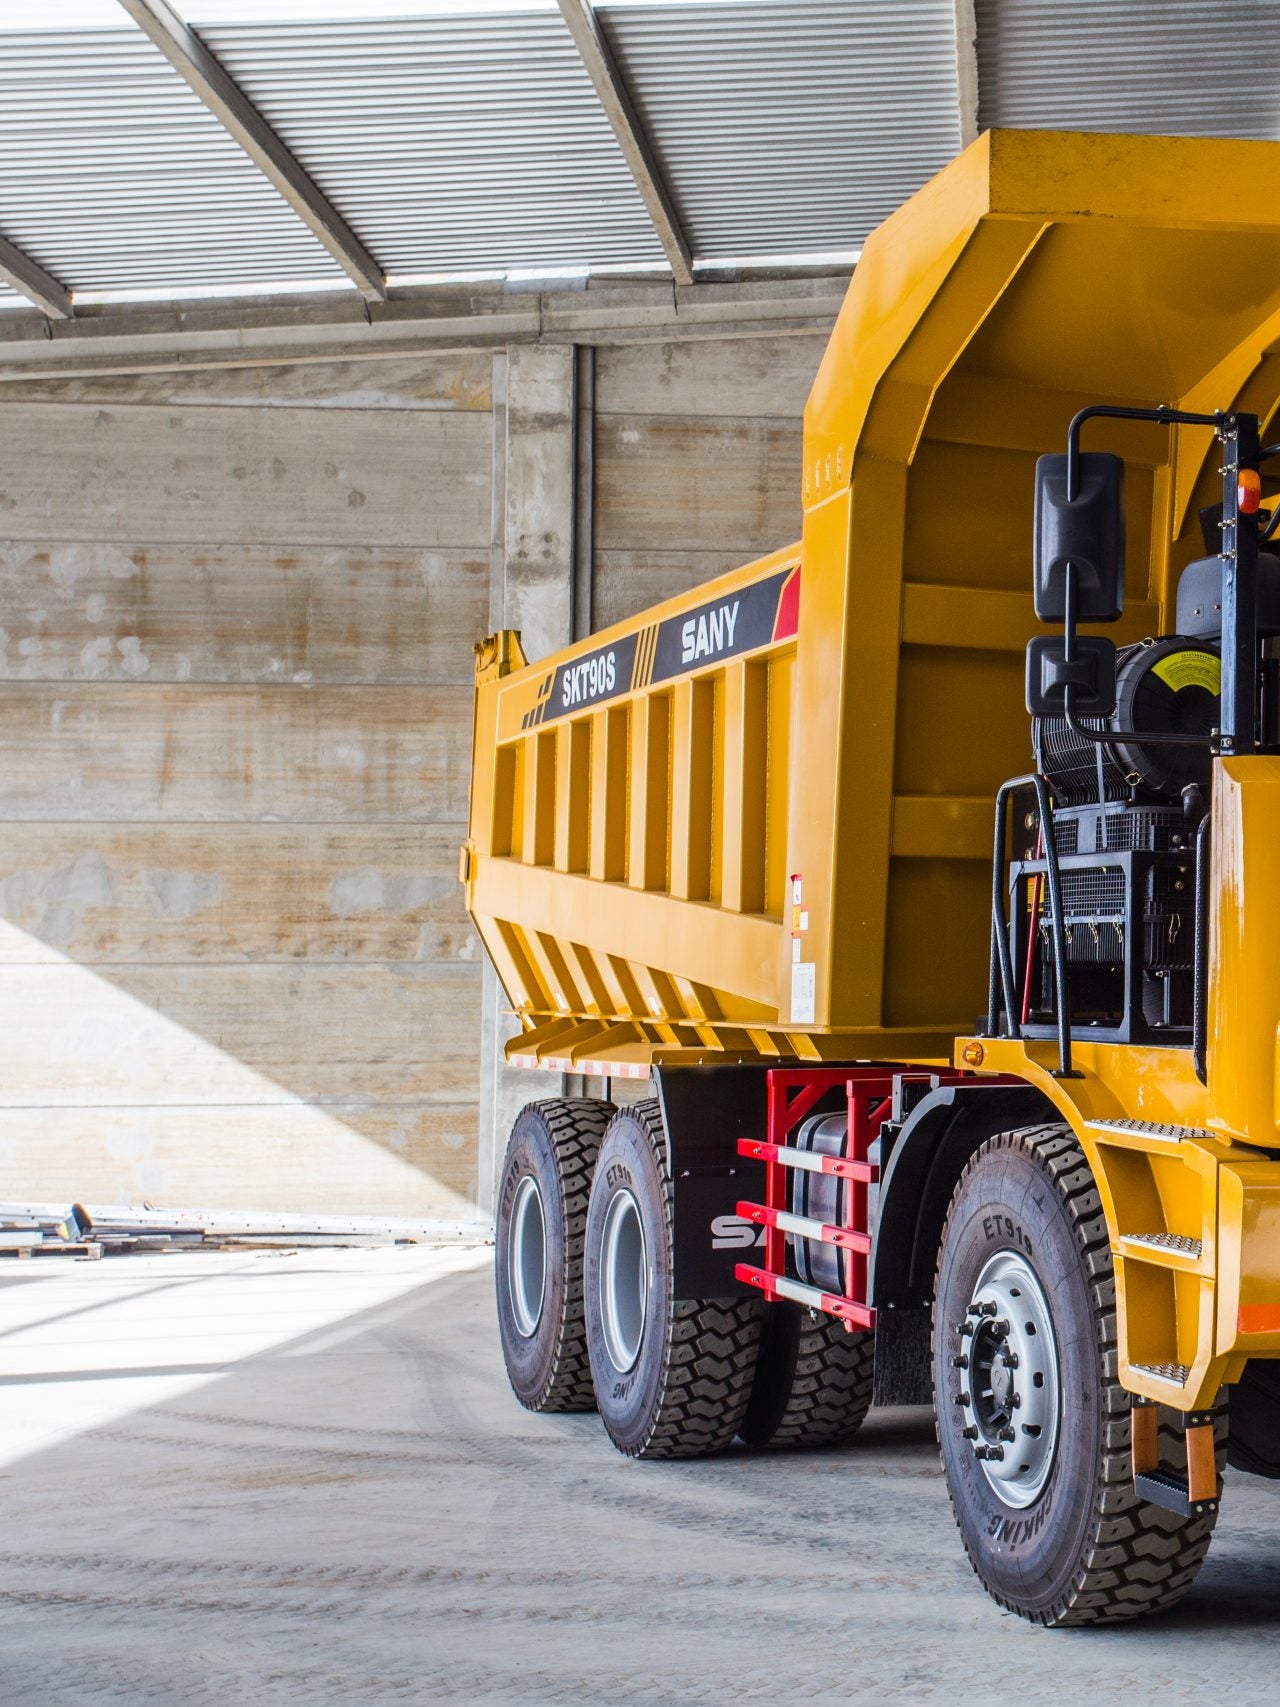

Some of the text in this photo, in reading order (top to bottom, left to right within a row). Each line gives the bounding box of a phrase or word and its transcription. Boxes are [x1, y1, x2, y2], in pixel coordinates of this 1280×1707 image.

[562, 600, 740, 707] SKT90S SANY
[605, 1163, 632, 1189] ET919
[983, 1214, 1033, 1257] ET919
